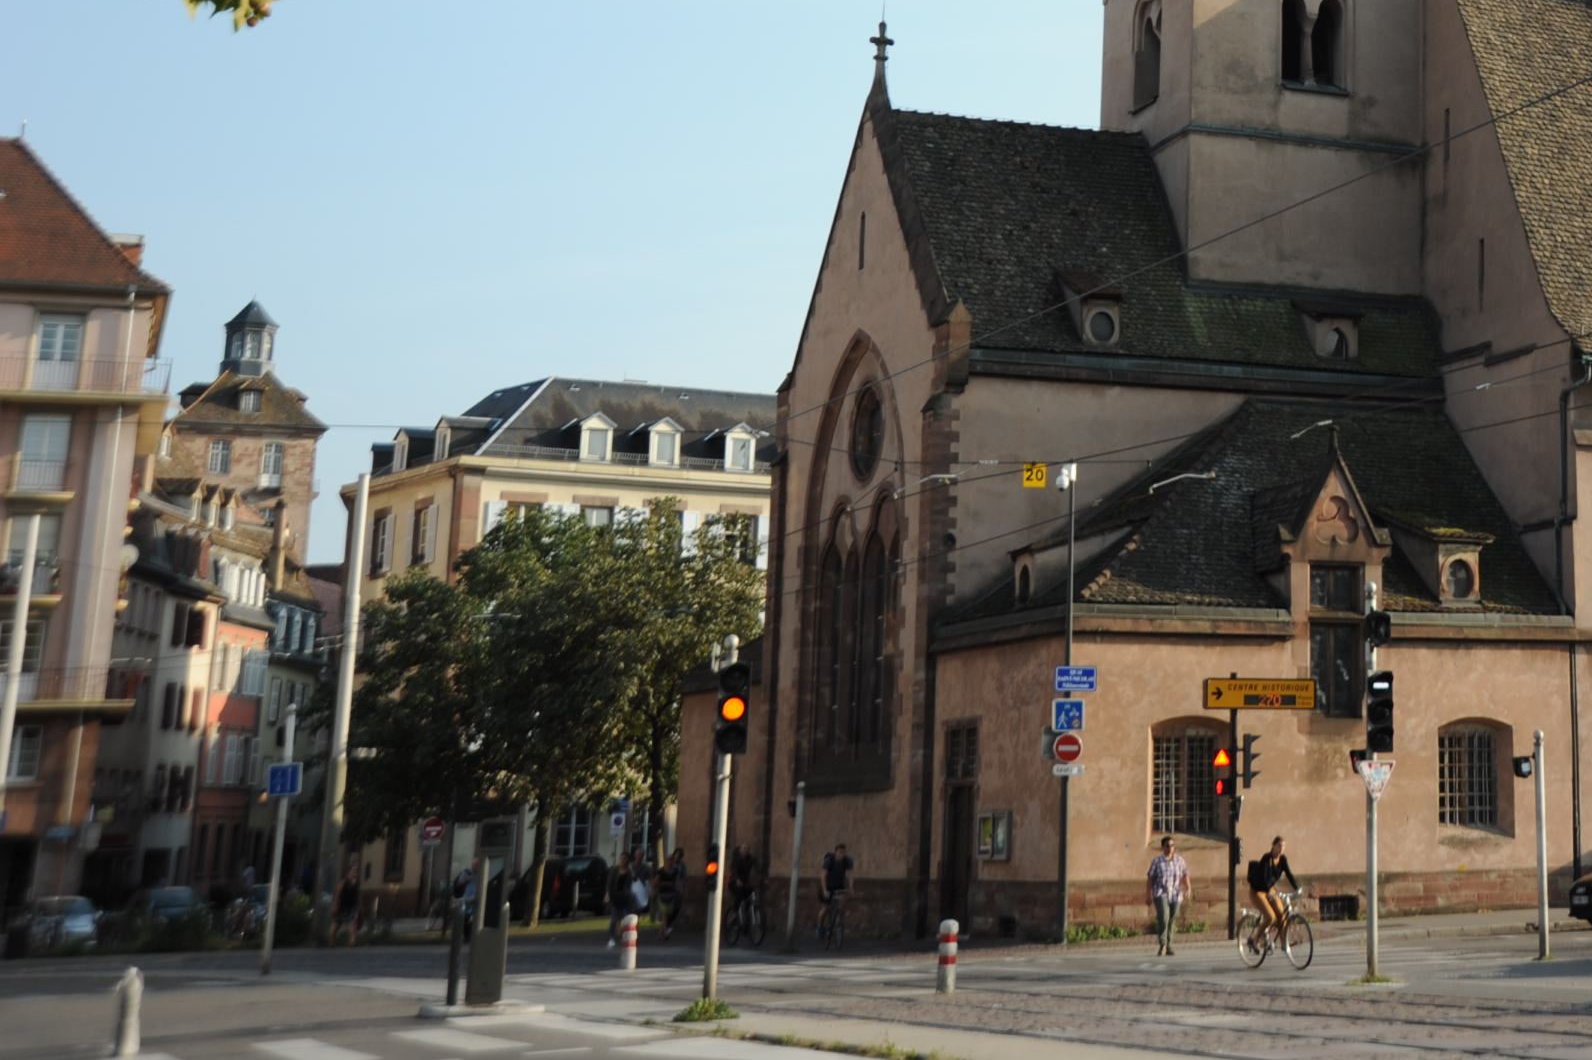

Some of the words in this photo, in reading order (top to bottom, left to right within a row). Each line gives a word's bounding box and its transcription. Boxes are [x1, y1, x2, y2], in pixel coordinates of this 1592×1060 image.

[1025, 468, 1044, 481] 20
[1227, 683, 1258, 691] CENTRE
[1262, 683, 1311, 692] HISTORIQUE
[1258, 694, 1282, 707] 270
